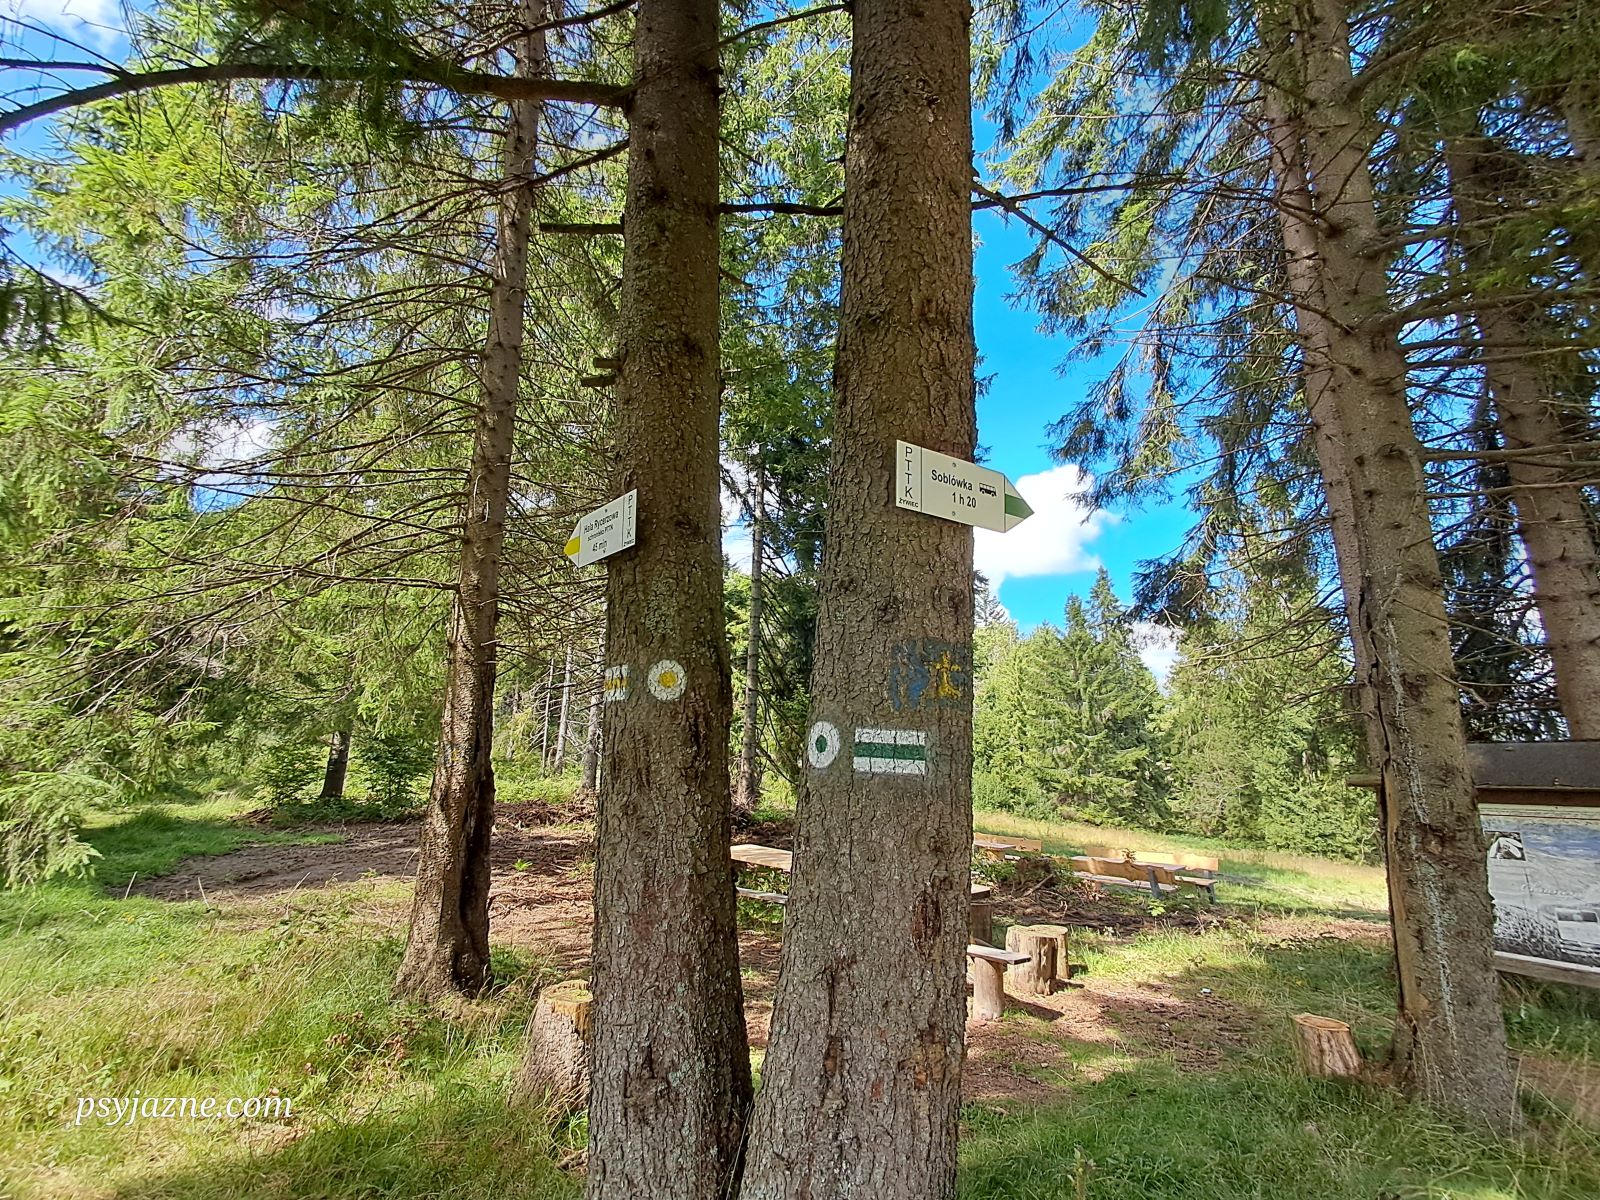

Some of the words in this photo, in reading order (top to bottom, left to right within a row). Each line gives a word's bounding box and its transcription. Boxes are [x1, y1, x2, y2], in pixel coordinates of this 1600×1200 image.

[904, 446, 913, 499] PTTK
[931, 469, 973, 491] Soblówka
[952, 492, 956, 503] 1
[959, 493, 965, 506] h
[967, 497, 977, 508] 20
